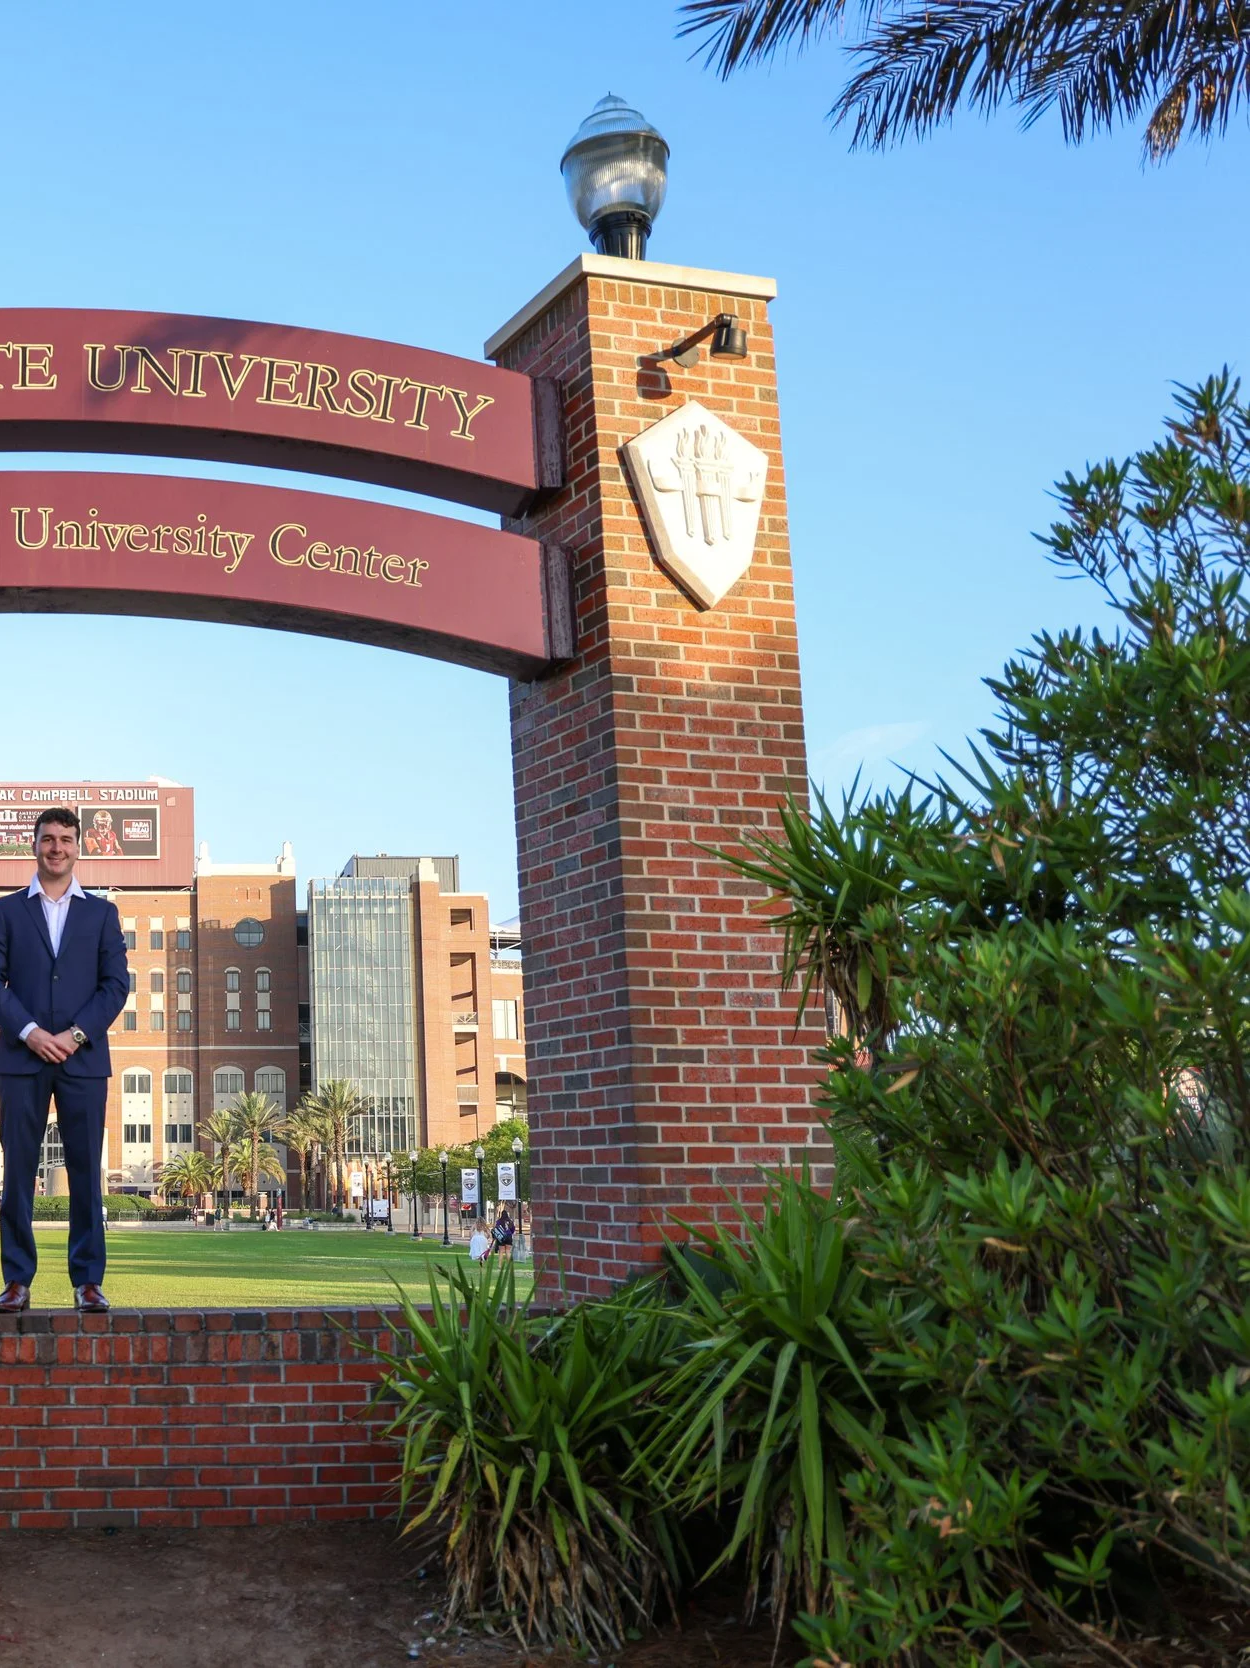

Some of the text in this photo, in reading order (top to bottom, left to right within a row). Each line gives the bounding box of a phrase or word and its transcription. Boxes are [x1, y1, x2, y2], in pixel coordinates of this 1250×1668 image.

[83, 343, 494, 441] UNIVERSITY
[11, 507, 255, 573] University
[268, 523, 430, 588] Center
[22, 789, 93, 801] CAMPBELL
[99, 789, 158, 801] STADIUM
